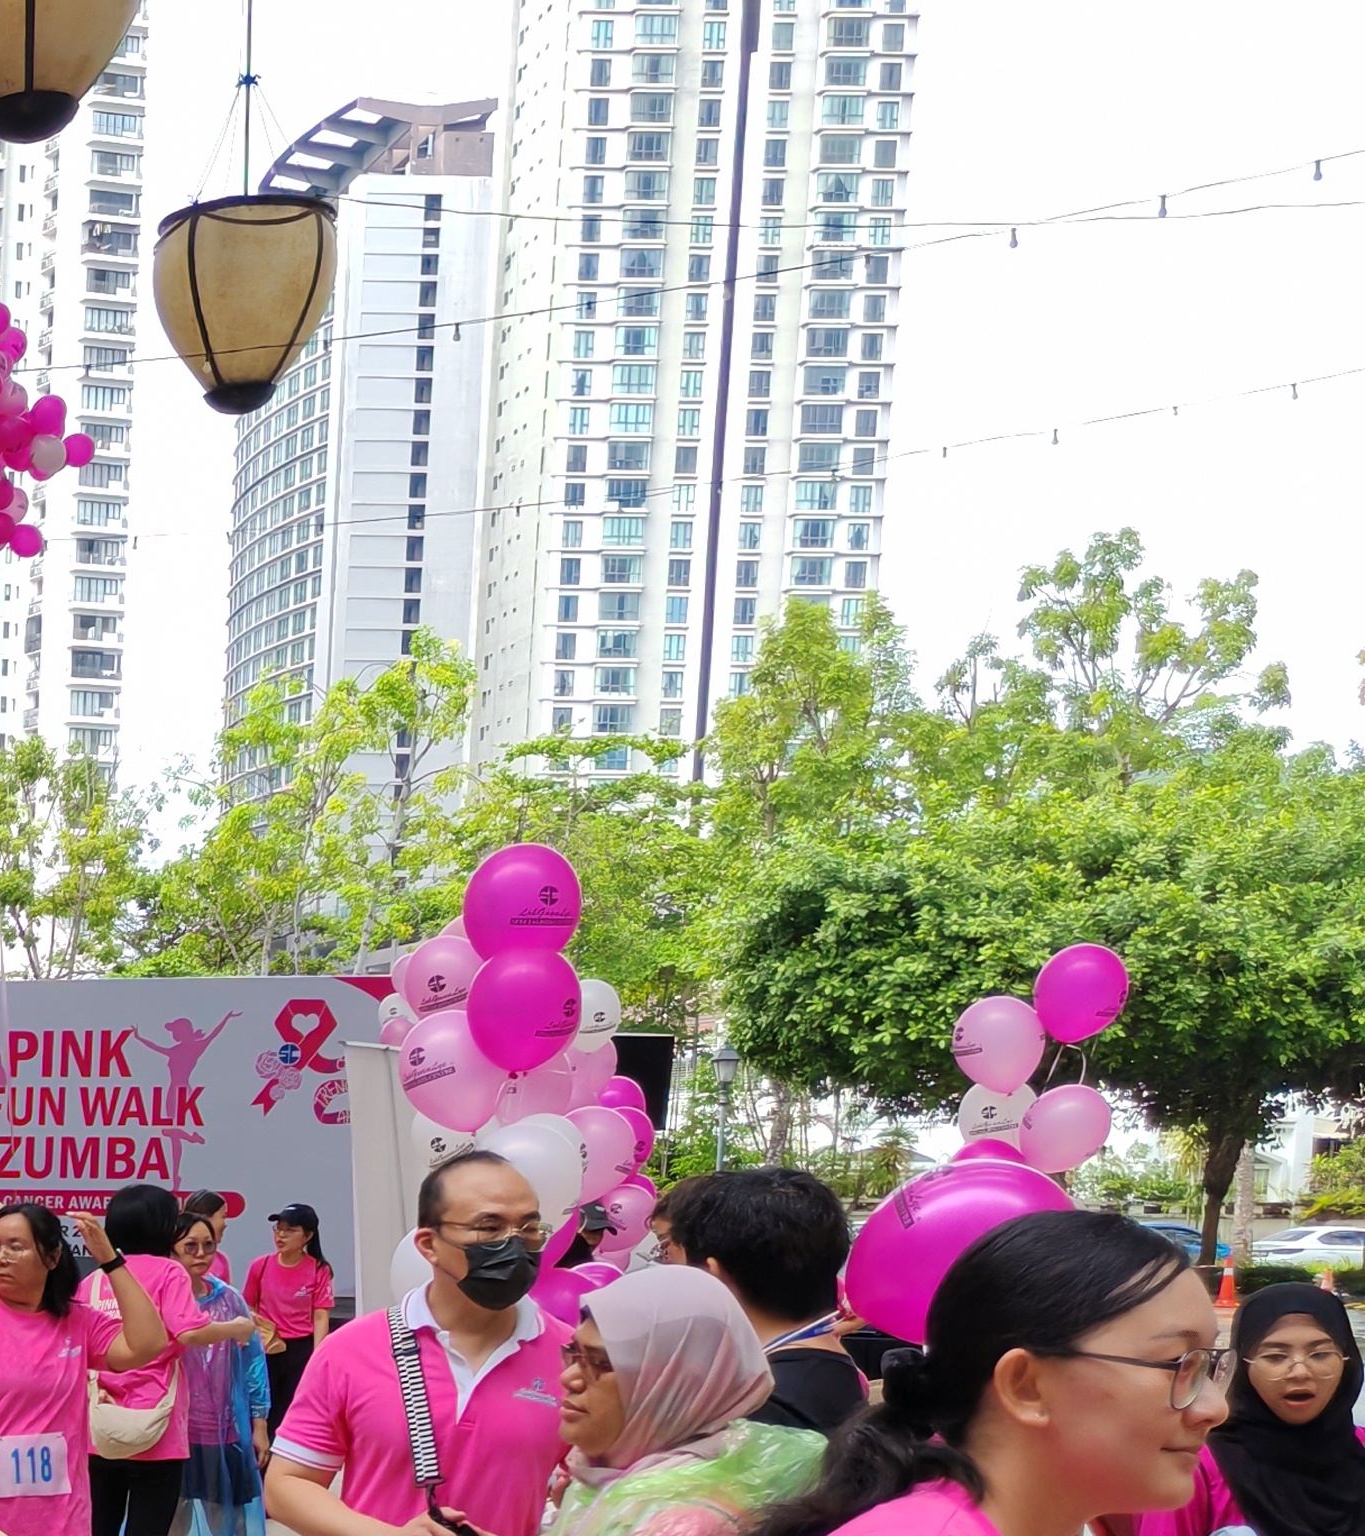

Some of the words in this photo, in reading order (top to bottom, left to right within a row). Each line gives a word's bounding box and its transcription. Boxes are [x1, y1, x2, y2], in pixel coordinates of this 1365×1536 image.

[8, 1030, 133, 1078] PINK
[79, 1086, 205, 1126] WALK
[3, 1195, 64, 1209] CANCER
[11, 1446, 52, 1484] 118
